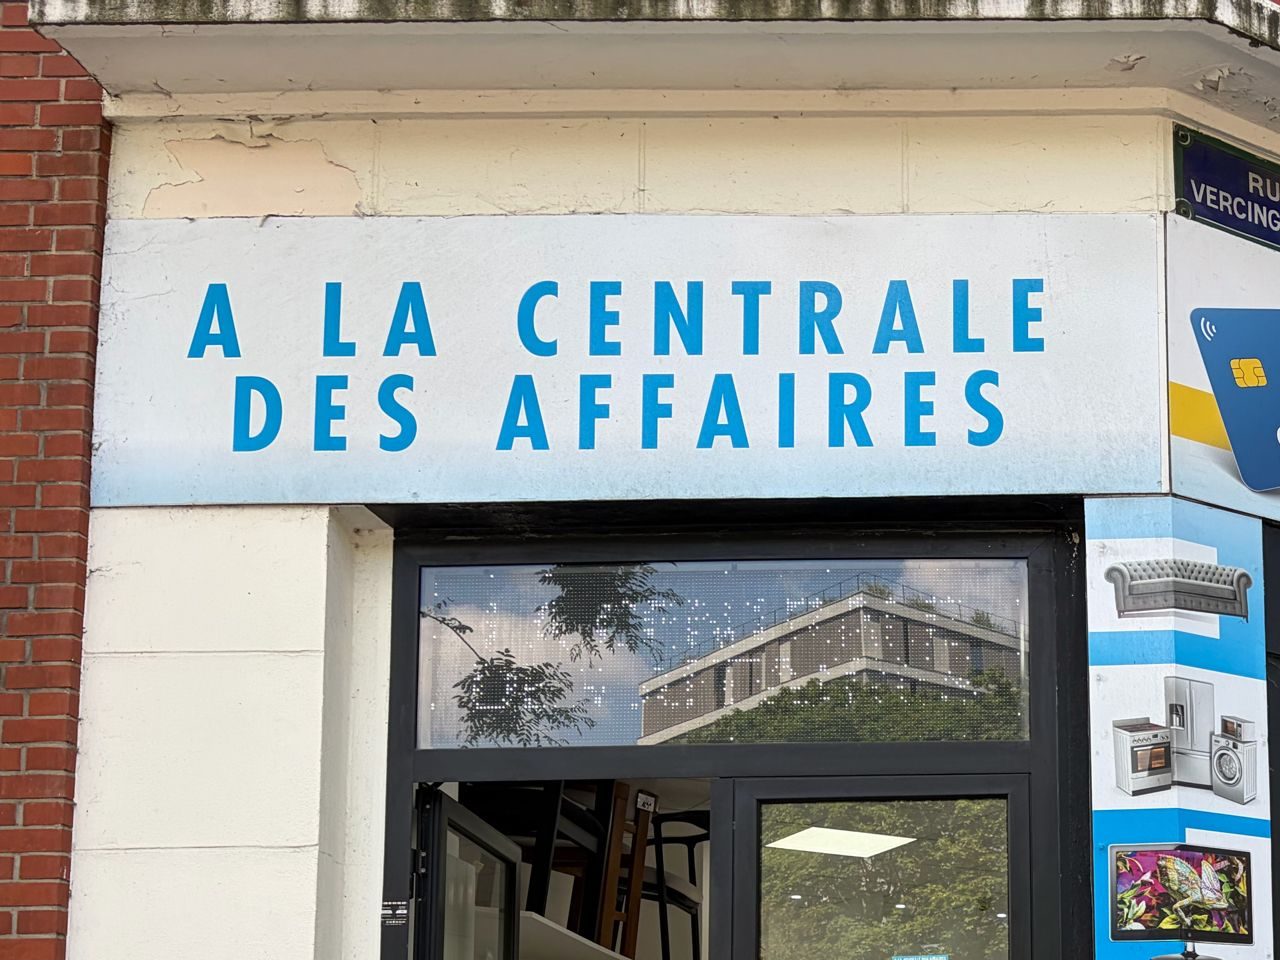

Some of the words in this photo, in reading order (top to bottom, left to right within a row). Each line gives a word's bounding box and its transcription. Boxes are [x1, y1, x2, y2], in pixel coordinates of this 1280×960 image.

[187, 282, 241, 358] A
[323, 281, 436, 357] LA
[517, 277, 1047, 357] CENTRALE
[232, 374, 418, 452] DES
[496, 369, 1004, 450] AFFAIRES
